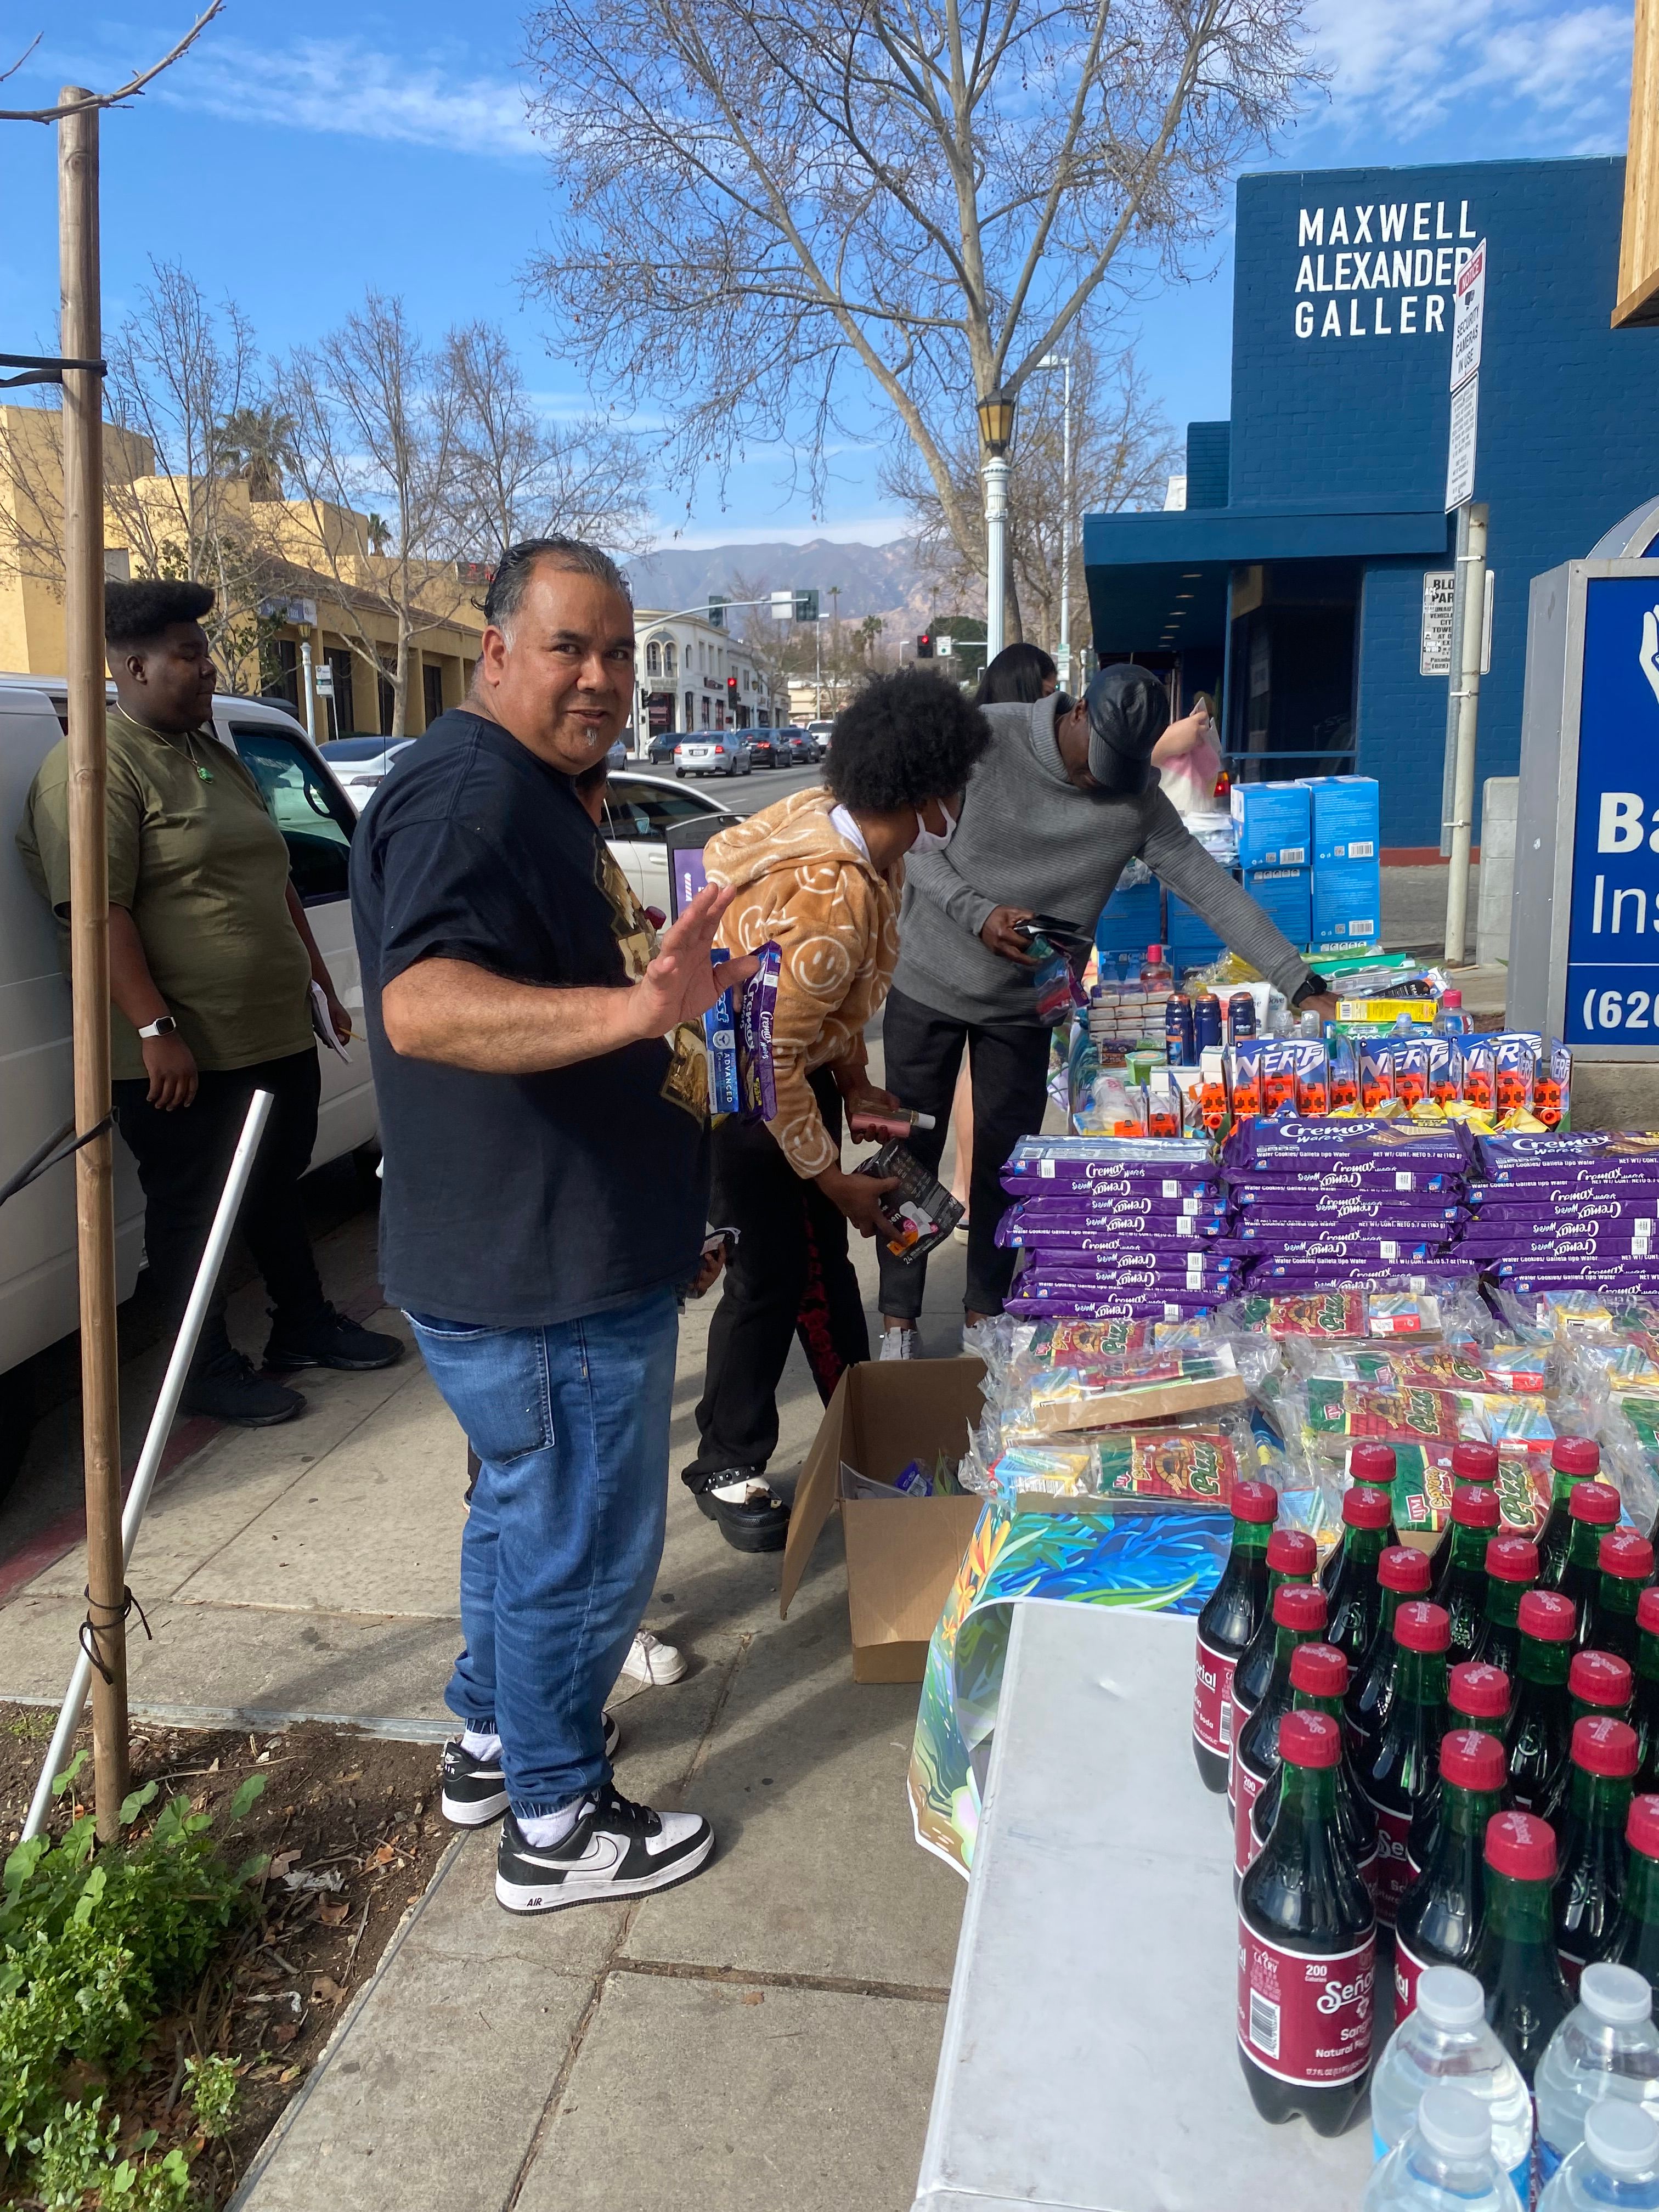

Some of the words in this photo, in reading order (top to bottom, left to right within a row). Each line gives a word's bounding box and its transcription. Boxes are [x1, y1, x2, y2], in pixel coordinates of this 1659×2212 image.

[1298, 200, 1477, 247] MAXWELL
[1461, 258, 1480, 290] NOTICE
[1294, 294, 1456, 338] GALLER
[1457, 303, 1480, 339] SECURITY
[1455, 324, 1479, 357] CAMERAS
[1458, 359, 1464, 374] IN
[1464, 348, 1474, 369] USE
[1598, 792, 1659, 853] B
[760, 1011, 773, 1043] Cremax
[1237, 1043, 1325, 1078] NERF
[1361, 1042, 1449, 1080] NERF
[724, 1053, 732, 1103] ADVANCED
[1279, 1122, 1379, 1138] Cremax
[1513, 1136, 1612, 1150] Cremax
[1086, 1163, 1124, 1178] Cremax
[1092, 1180, 1131, 1197] Cremax
[1319, 1172, 1361, 1188] Cremax
[1113, 1198, 1152, 1214] Cremax
[1578, 1201, 1621, 1219] Cremax
[1106, 1216, 1144, 1234] Cremax
[1556, 1220, 1599, 1238] Cremax
[1306, 1241, 1347, 1256] Cremax
[1554, 1238, 1596, 1256] Cremax
[1116, 1254, 1156, 1268] Cremax
[1116, 1270, 1155, 1286] Cremax
[1094, 1304, 1133, 1318] Cremax
[1424, 1466, 1451, 1509] SAVORY
[1244, 1775, 1255, 1792] 200
[527, 1898, 542, 1906] AIR
[1306, 1965, 1327, 1976] 200
[1316, 2045, 1353, 2057] Natural
